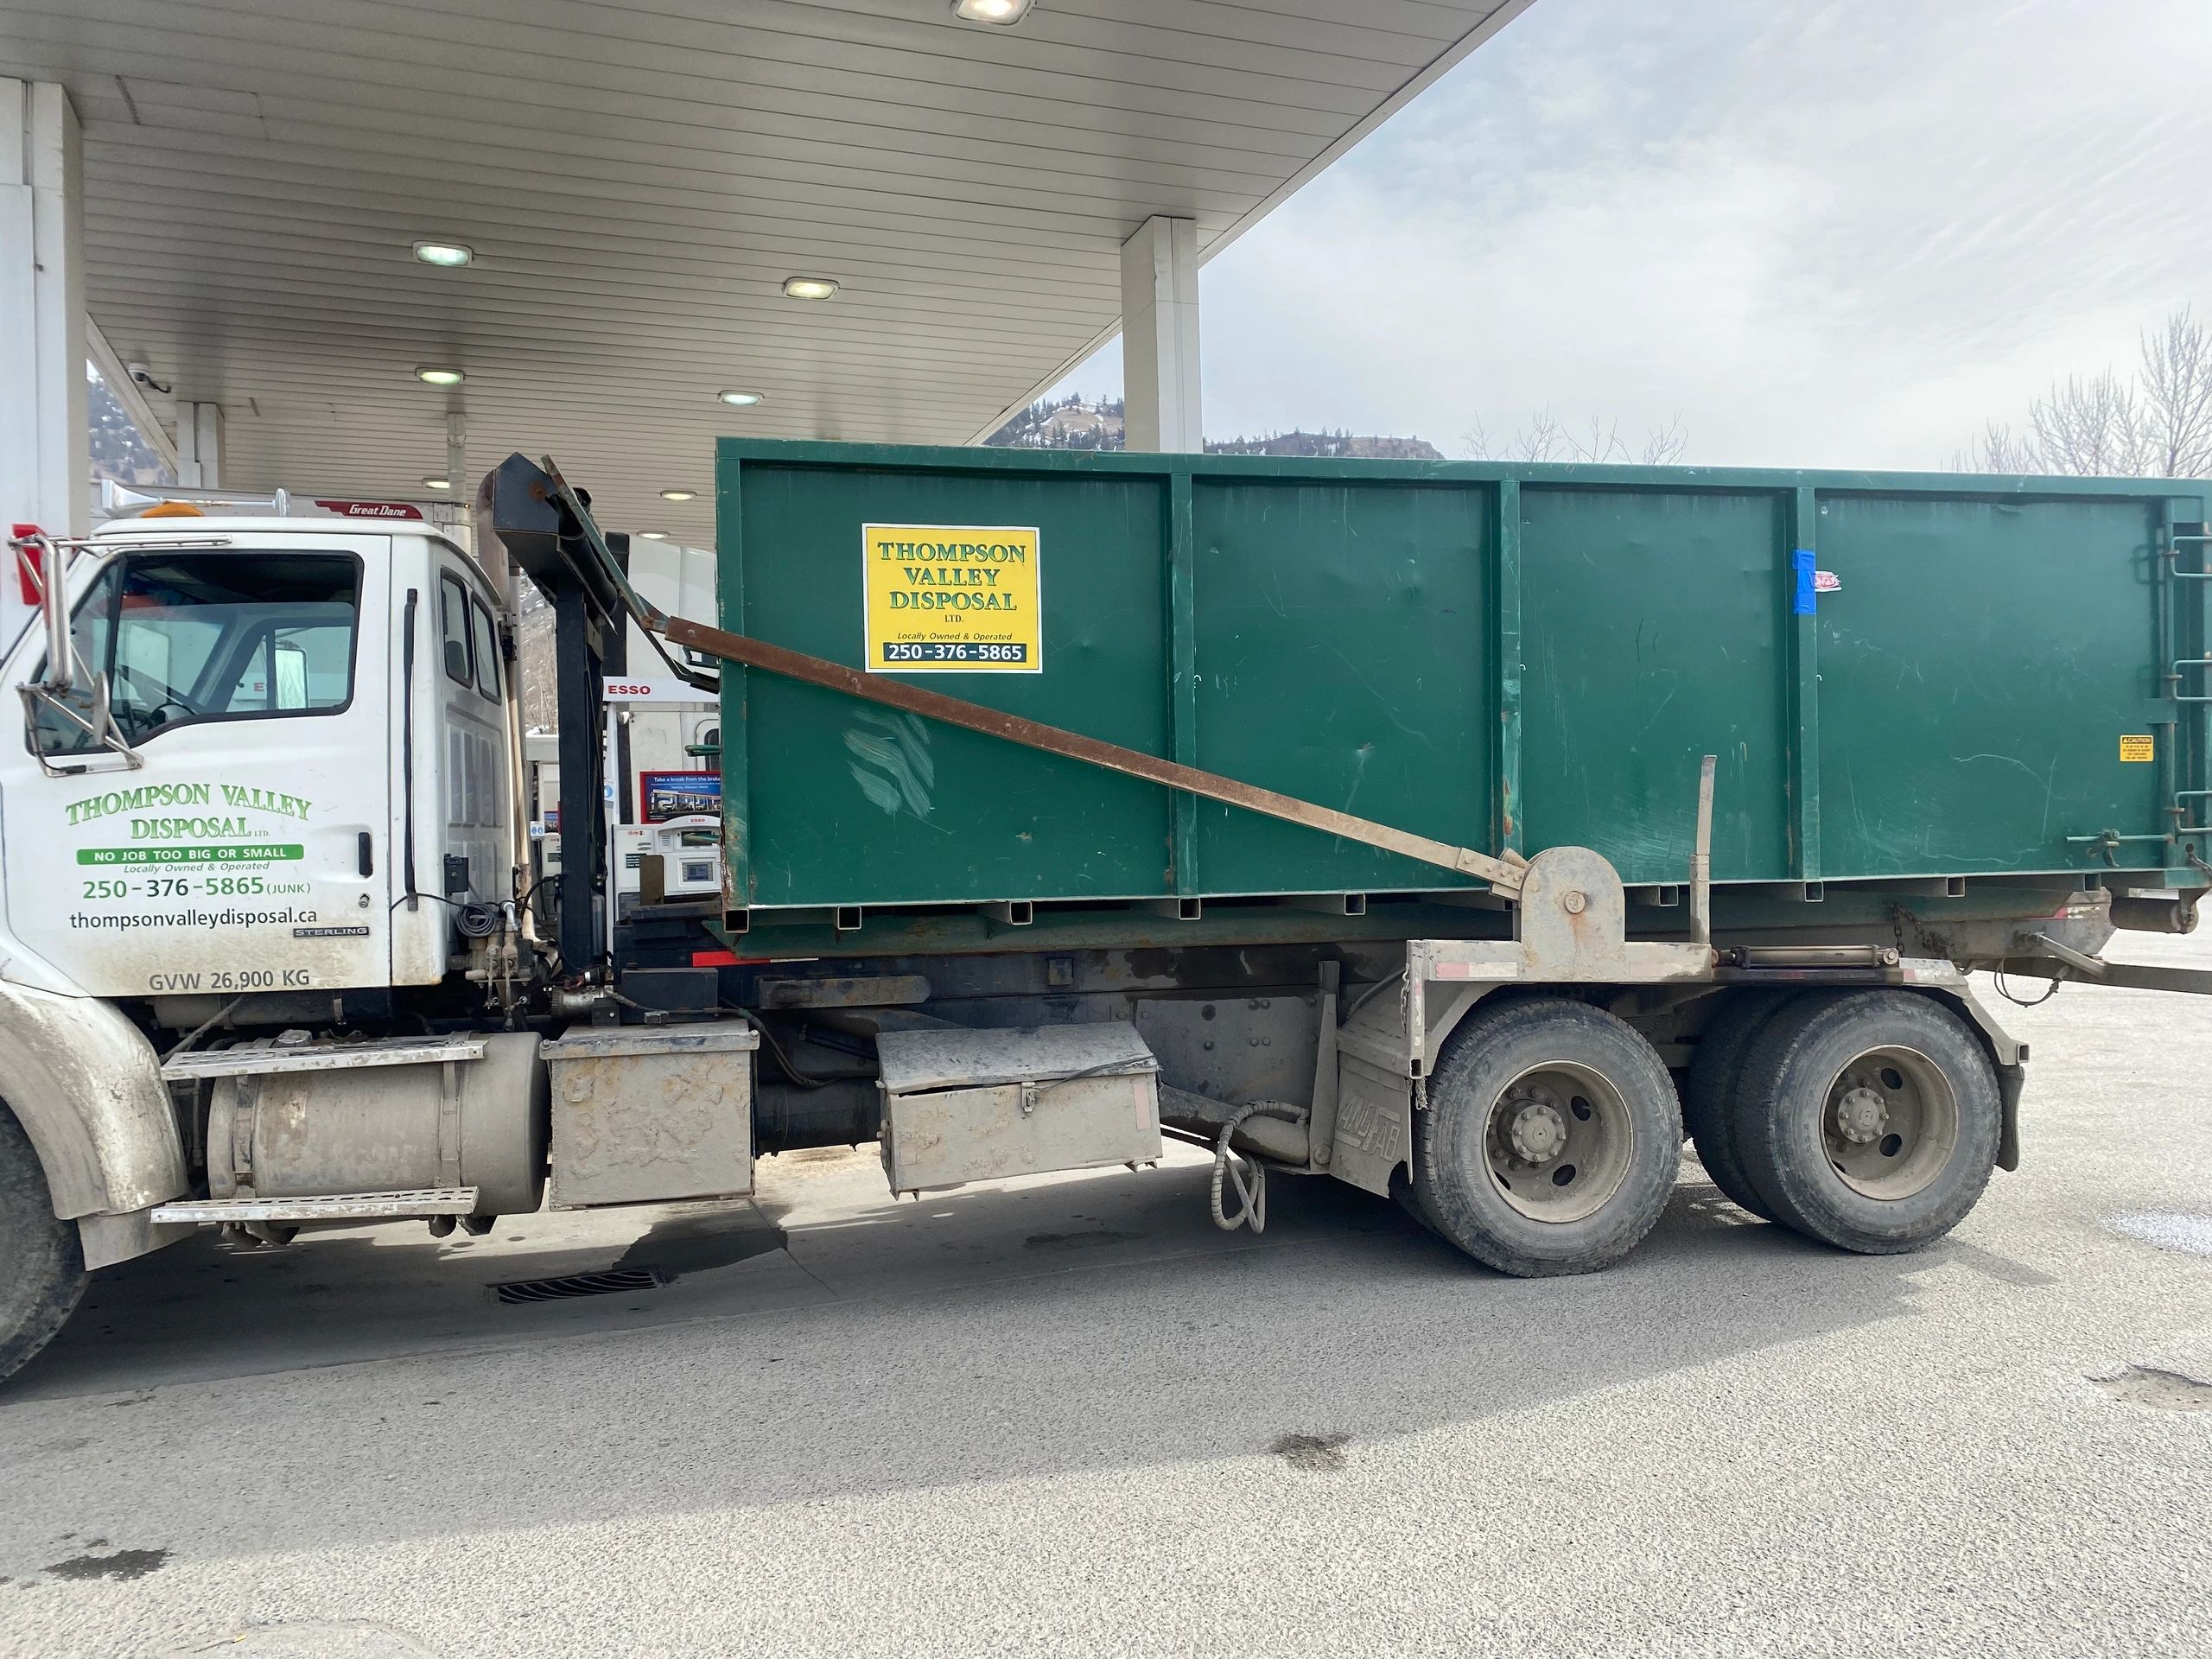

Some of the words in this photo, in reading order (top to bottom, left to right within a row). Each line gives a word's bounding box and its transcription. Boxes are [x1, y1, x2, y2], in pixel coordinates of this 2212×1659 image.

[349, 504, 378, 515] Great
[379, 505, 406, 517] Dane
[877, 542, 1026, 563] THOMPSON
[903, 567, 1001, 586] VALLEY
[889, 591, 1017, 611] DISPOSAL
[944, 614, 963, 623] LTD.
[898, 632, 926, 641] Locally
[974, 632, 1013, 641] Operated
[888, 645, 1022, 660] 250-376-5865
[607, 685, 651, 695] ESSO
[65, 783, 211, 826] THOMPSON
[220, 784, 313, 822] VALLEY
[130, 817, 251, 840] DISPOSAL
[94, 852, 115, 861] NO
[122, 851, 147, 862] JOB
[153, 850, 182, 861] TOO
[188, 849, 211, 860] BIG
[218, 849, 236, 859] OR
[243, 847, 287, 858] SMALL
[124, 864, 161, 874] Locally
[165, 863, 204, 873] Owned
[220, 861, 270, 872] Operated
[82, 877, 264, 899] 250-376-5865
[266, 882, 311, 895] (JUNK)
[69, 906, 318, 931] thompsonvalleydisposal.ca
[295, 927, 368, 937] STERLING
[149, 973, 201, 991] GVW
[211, 971, 274, 990] 26,900
[283, 969, 310, 986] KG
